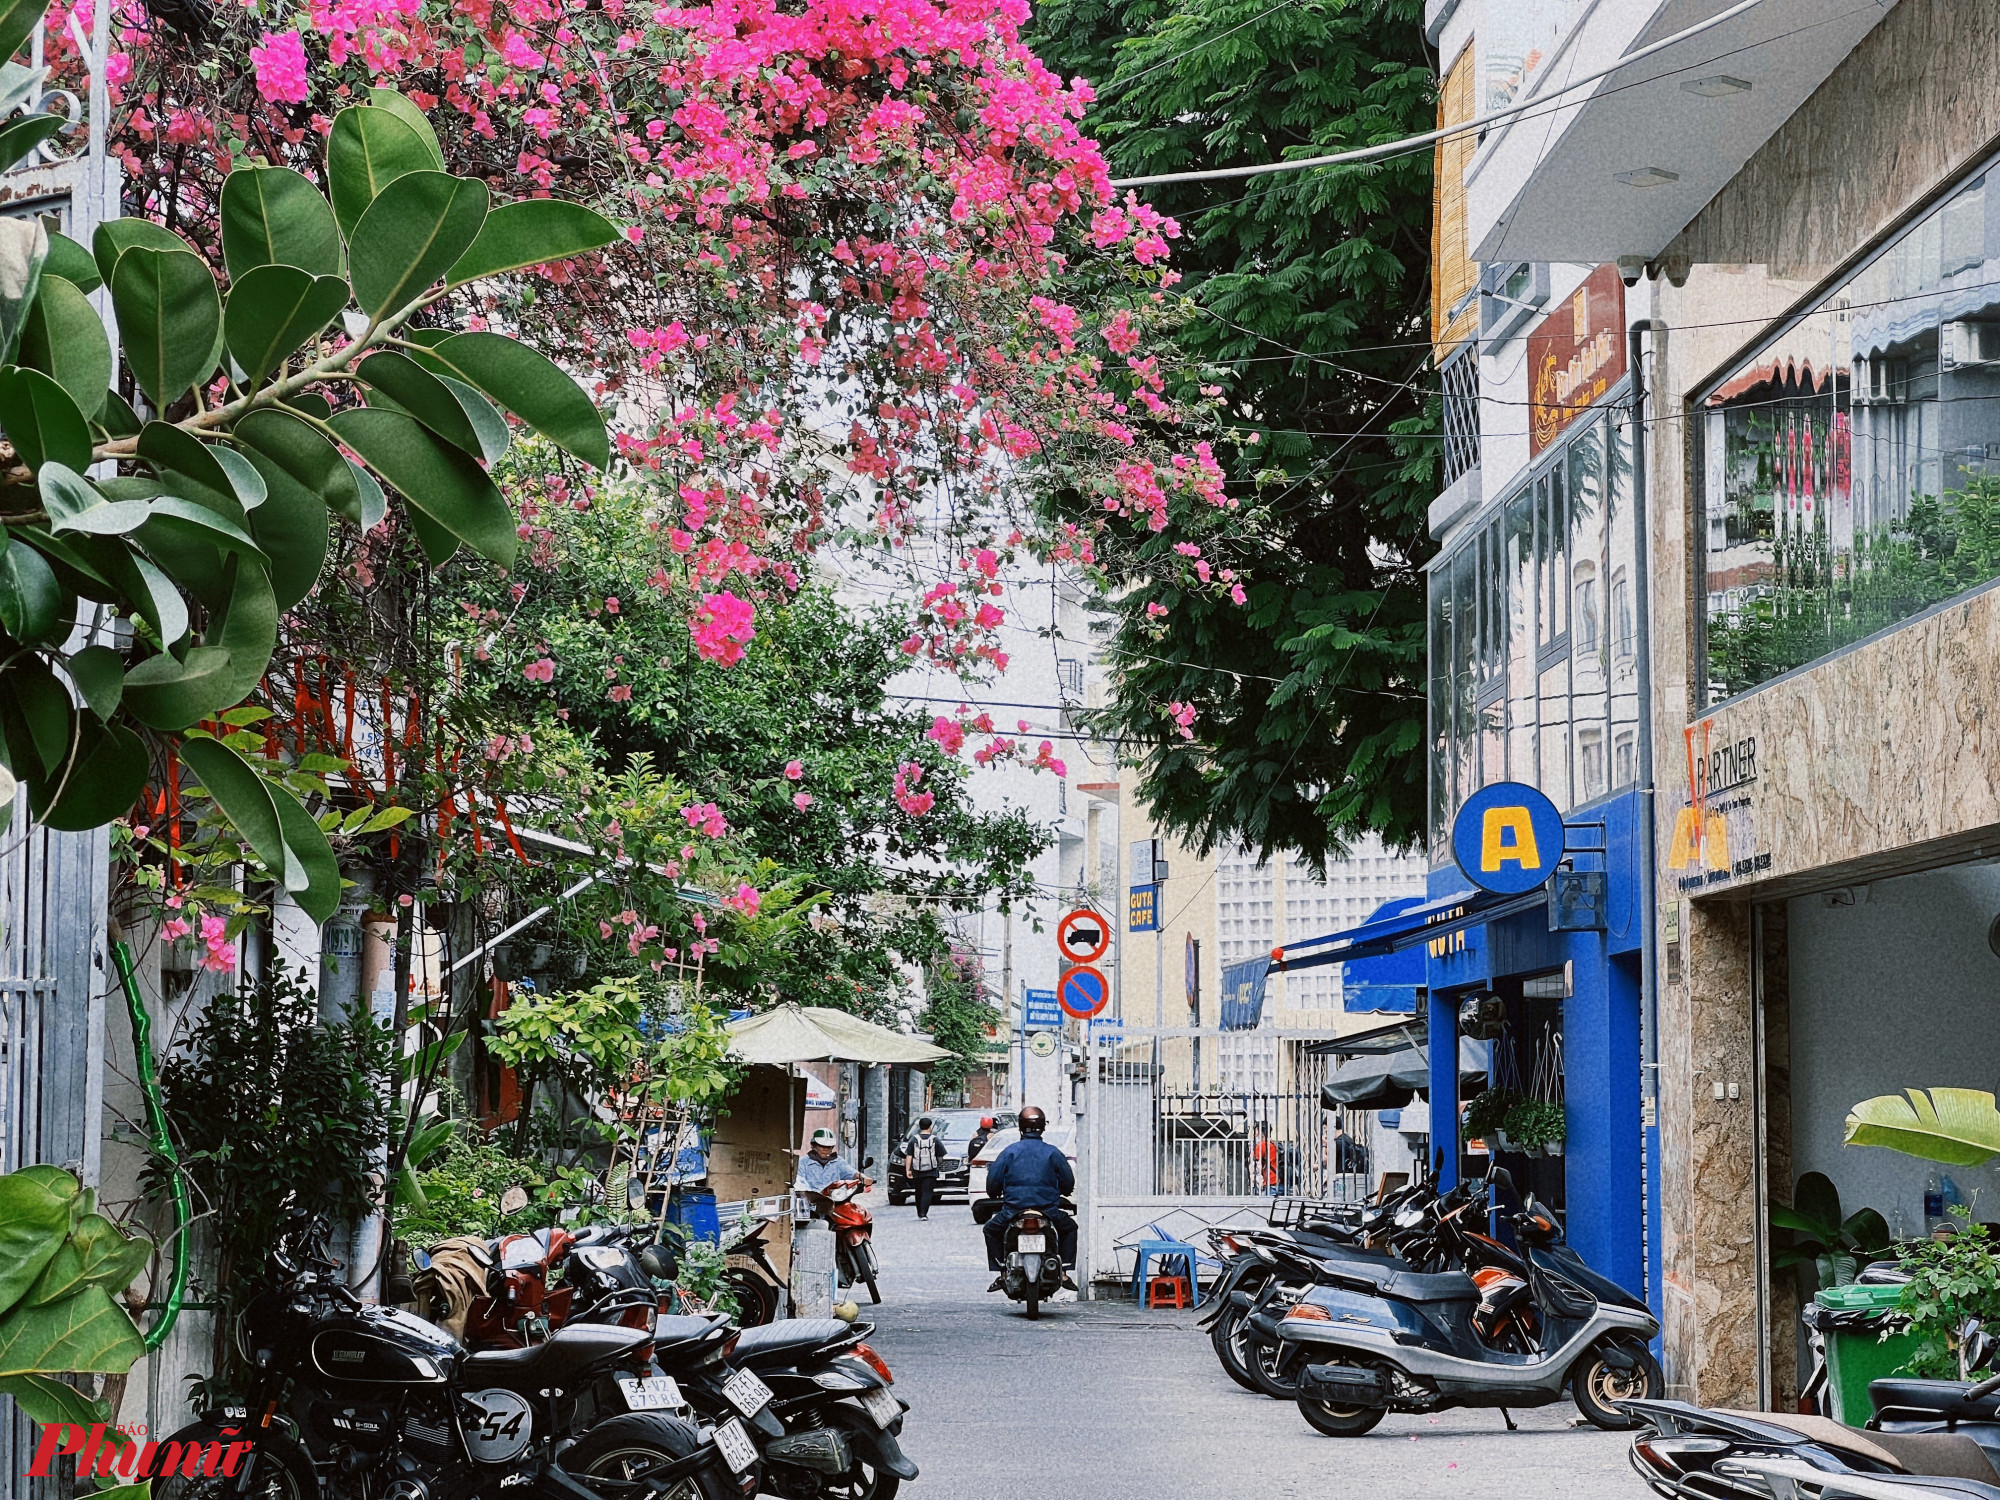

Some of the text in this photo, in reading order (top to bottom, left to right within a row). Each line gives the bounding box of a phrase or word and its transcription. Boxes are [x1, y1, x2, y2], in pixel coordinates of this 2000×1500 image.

[1481, 806, 1540, 872] A
[1131, 891, 1153, 908] GUTA
[1131, 909, 1153, 926] CAFE
[739, 1384, 770, 1414] 366.96
[480, 1411, 526, 1441] 54
